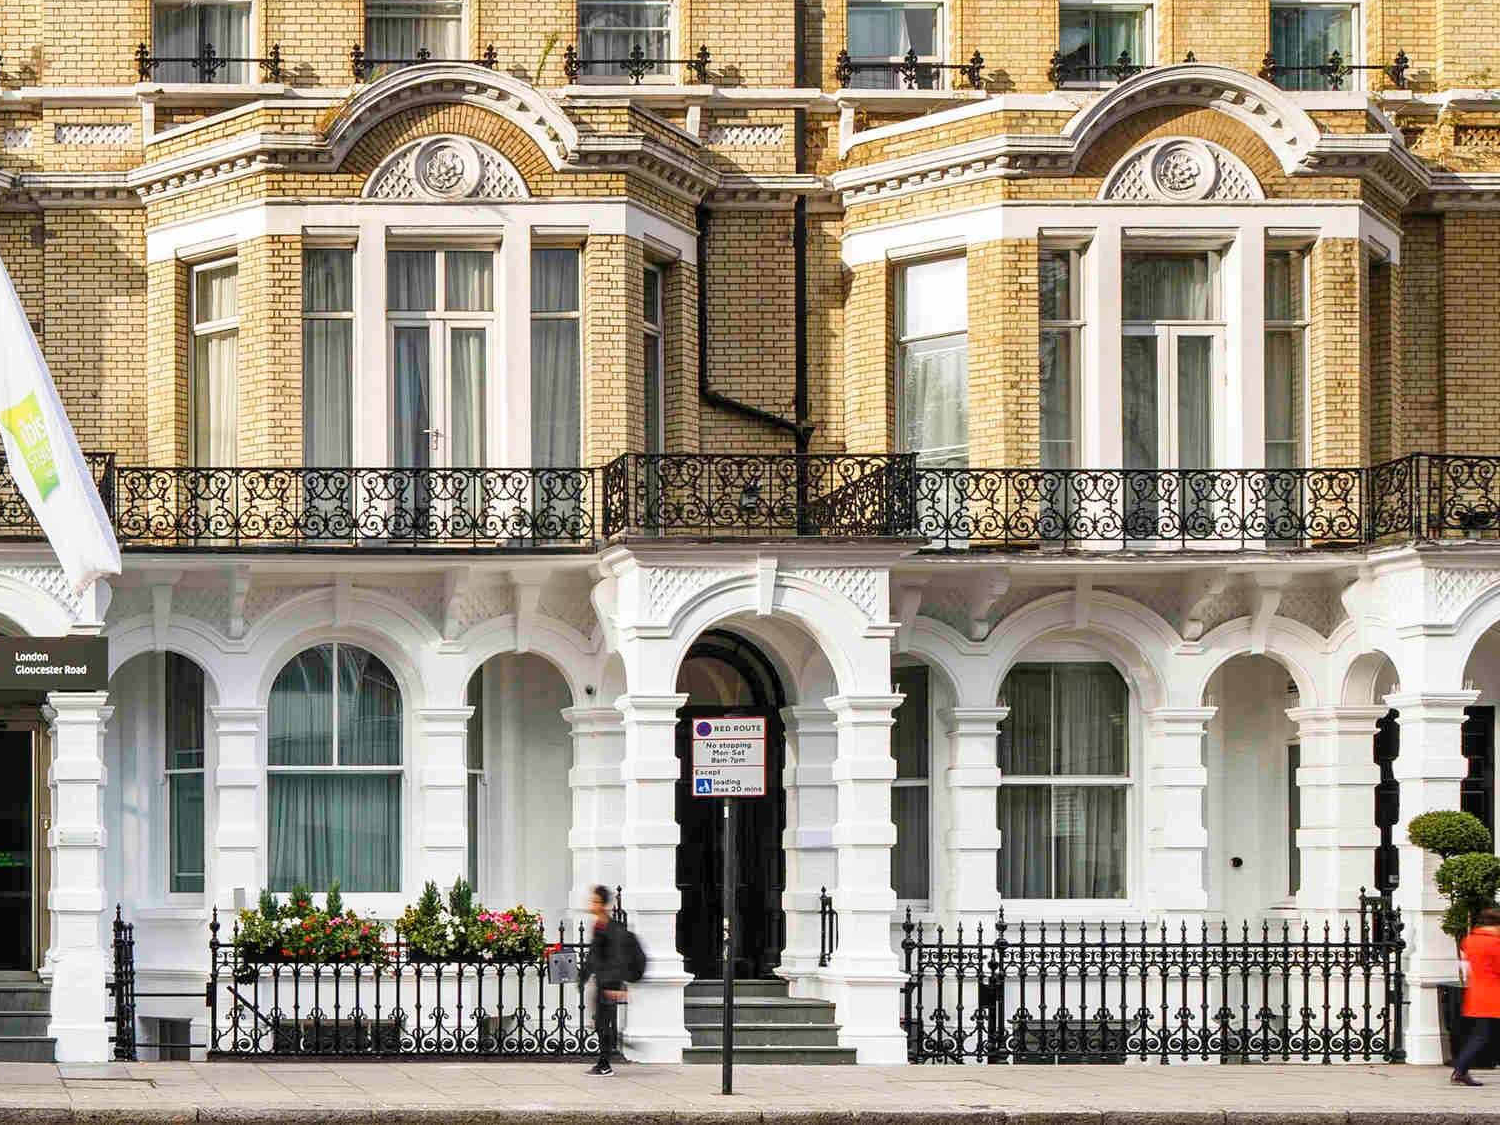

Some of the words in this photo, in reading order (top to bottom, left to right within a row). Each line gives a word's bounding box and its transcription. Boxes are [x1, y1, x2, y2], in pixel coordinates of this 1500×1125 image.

[15, 652, 49, 662] London
[15, 665, 63, 675] Gloucester
[64, 665, 87, 675] Road
[733, 724, 762, 732] ROUTE
